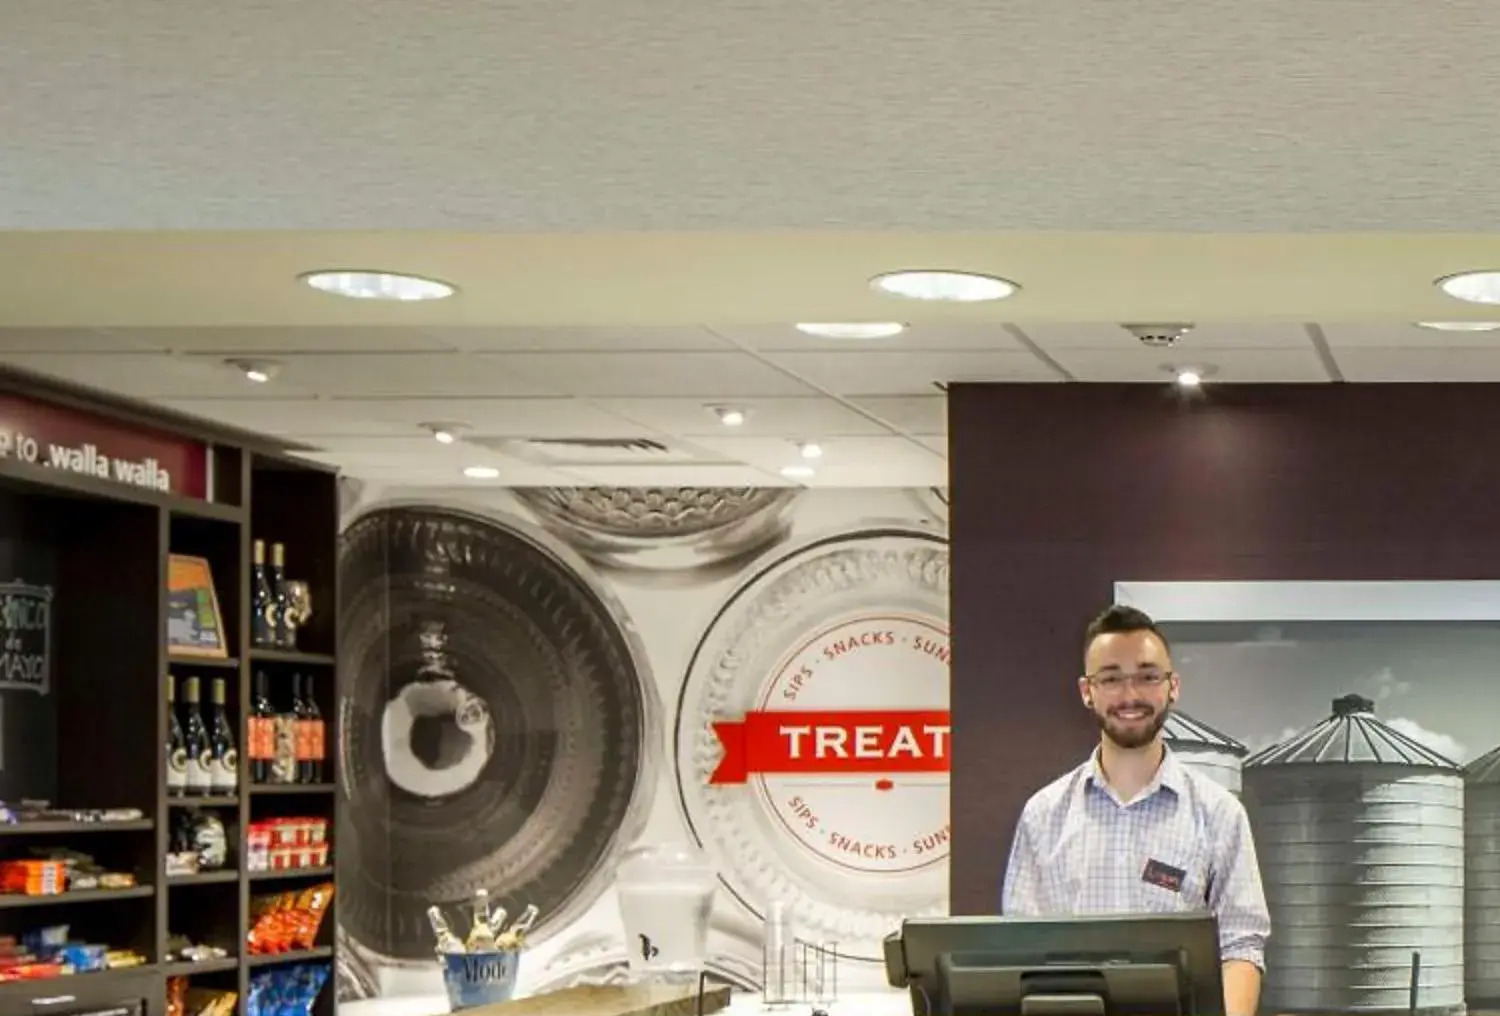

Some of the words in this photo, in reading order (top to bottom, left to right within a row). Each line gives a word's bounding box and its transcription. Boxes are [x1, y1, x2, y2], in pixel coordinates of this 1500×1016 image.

[16, 432, 38, 463] to
[114, 458, 169, 493] walla
[784, 662, 813, 701] SIPS
[823, 631, 895, 661] SNACKS
[912, 635, 950, 666] SUN
[779, 724, 950, 759] TREAT
[788, 795, 819, 829] SIPS
[829, 831, 897, 859] SNACKS
[912, 825, 950, 855] SUN
